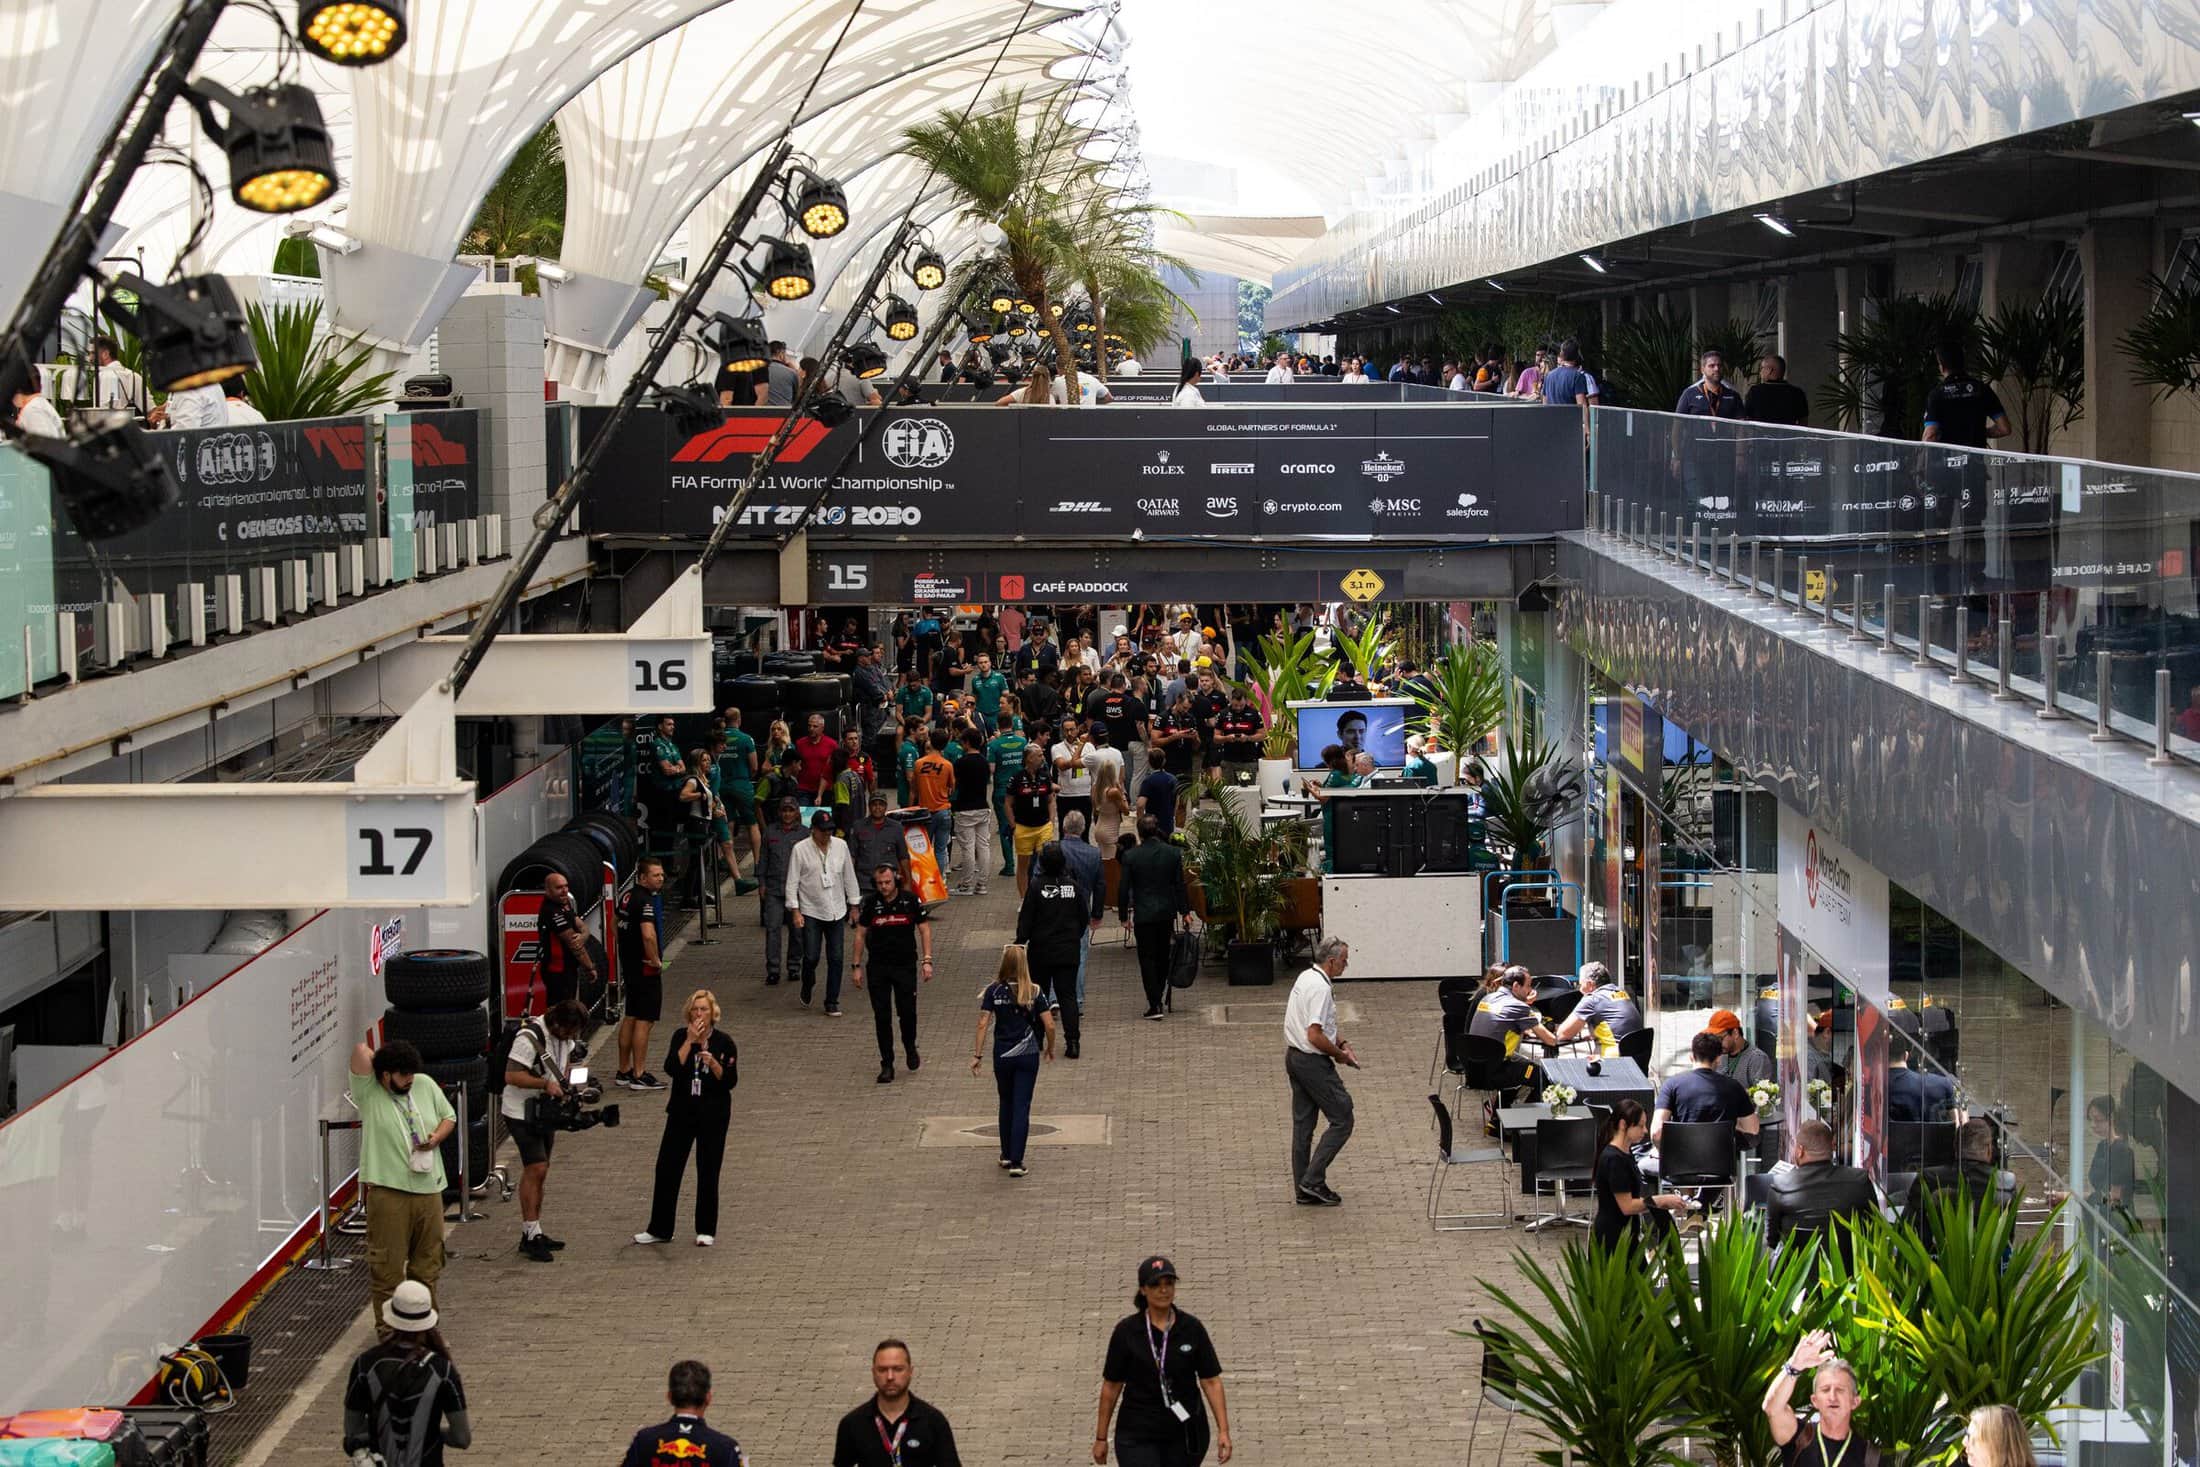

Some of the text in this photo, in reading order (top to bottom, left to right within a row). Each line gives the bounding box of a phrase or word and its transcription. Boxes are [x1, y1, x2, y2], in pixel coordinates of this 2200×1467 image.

[1206, 424, 1237, 432] GLOBAL
[1238, 424, 1278, 432] PARTNERS
[1143, 465, 1185, 475] ROLEX
[1210, 463, 1255, 475] PIRELLI
[1280, 463, 1336, 474] aramco
[1363, 462, 1402, 473] Heineken
[671, 476, 698, 489] FIA
[766, 476, 777, 489] 1
[780, 476, 828, 489] World
[1056, 501, 1104, 512] DHL
[1137, 498, 1179, 510] QATAR
[1206, 497, 1237, 508] aws
[1280, 501, 1342, 514] crypto.com
[1387, 499, 1421, 511] MSC
[852, 505, 922, 525] 2030
[1146, 508, 1180, 516] AIRWAYS
[1446, 507, 1489, 519] salesforce
[827, 565, 868, 590] 15
[1032, 580, 1129, 593] CAFÉ PADDOCK
[1349, 581, 1364, 590] 3,1
[634, 660, 687, 692] 16
[920, 762, 945, 775] 24
[358, 828, 433, 876] 17
